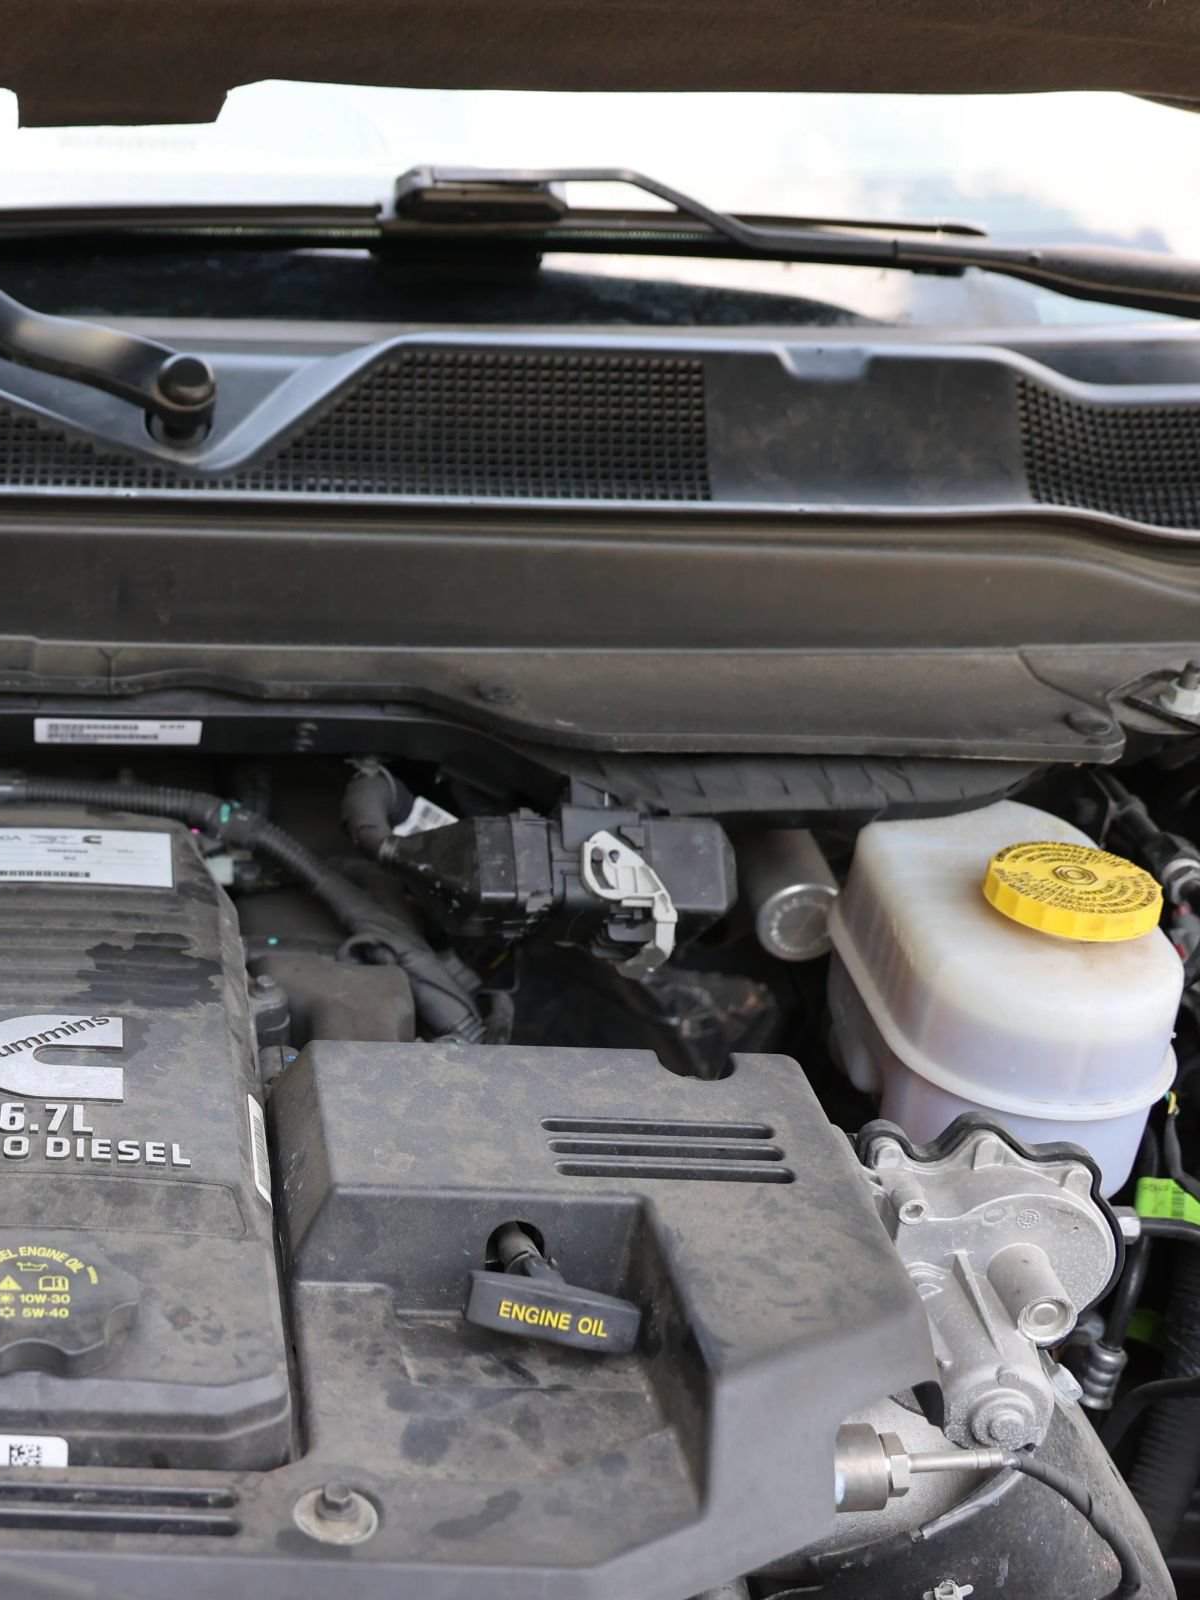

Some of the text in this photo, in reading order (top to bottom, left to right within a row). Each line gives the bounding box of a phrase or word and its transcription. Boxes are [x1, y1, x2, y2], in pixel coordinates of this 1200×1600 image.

[0, 1102, 93, 1135] 6.7L
[45, 1136, 192, 1168] DIESEL
[18, 1246, 69, 1263] ENGINE
[65, 1258, 85, 1274] OIL
[19, 1293, 71, 1304] 10W-30
[21, 1307, 69, 1318] 5W-40
[498, 1299, 608, 1338] ENGINE OIL
